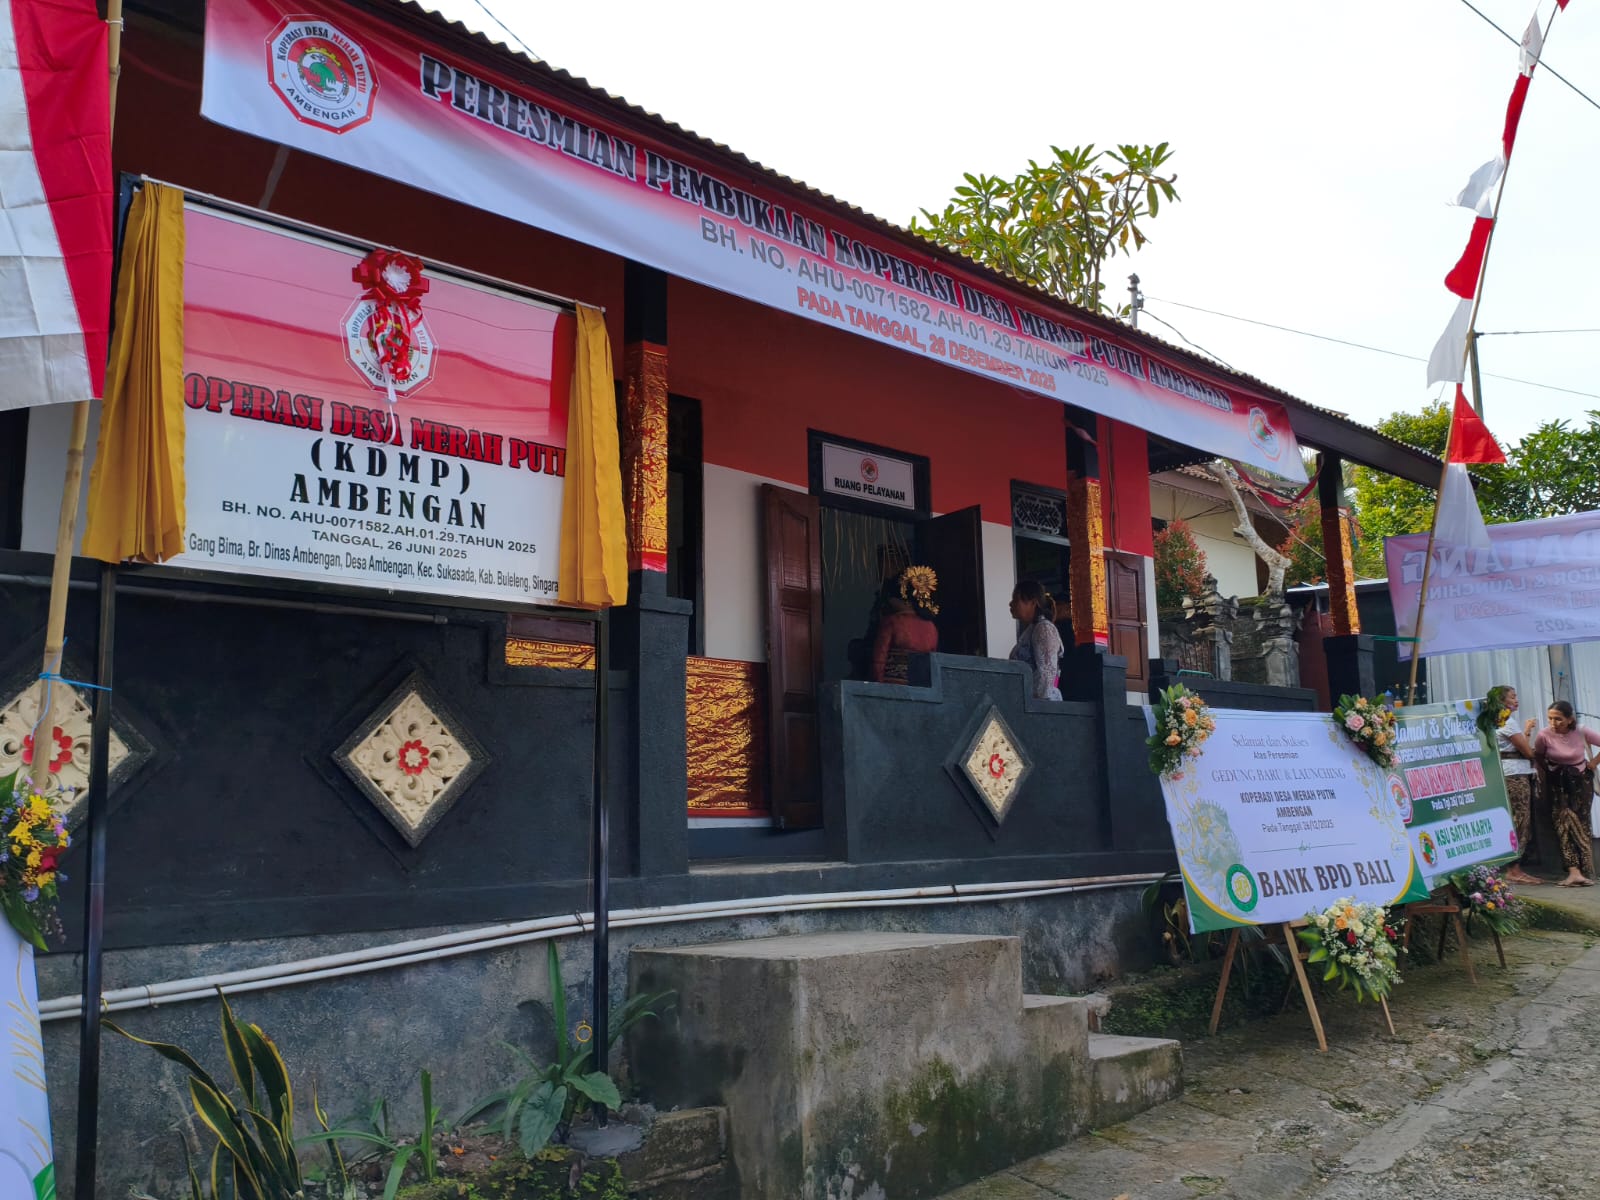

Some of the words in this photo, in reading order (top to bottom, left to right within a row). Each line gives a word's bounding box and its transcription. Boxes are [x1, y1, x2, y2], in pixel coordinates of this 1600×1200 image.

[277, 27, 304, 61] KOPERASI
[305, 26, 329, 39] DESA
[331, 32, 360, 63] MERAH
[355, 62, 367, 94] PUTIH
[286, 87, 356, 121] AMBENGAN
[420, 53, 636, 181] PERESMIAN
[644, 150, 828, 258] PEMBUKAAN
[831, 230, 960, 309] KOPERASI
[959, 282, 1017, 332] DESA
[1015, 306, 1088, 359] MERAH
[1088, 335, 1147, 381] PUTIH
[701, 216, 744, 255] BH.
[750, 237, 792, 273] NO.
[1073, 361, 1109, 387] 2025
[797, 287, 845, 323] PADA
[845, 304, 927, 353] TANGGAL,
[929, 334, 946, 357] 26
[948, 340, 1027, 383] DESEMBER
[1026, 367, 1056, 393] 2025
[184, 373, 324, 432] OPERASI
[330, 401, 403, 447] DESA
[410, 416, 503, 466] MERAH
[509, 436, 566, 478] PUTI
[289, 473, 487, 530] AMBENGAN
[834, 477, 861, 492] RUANG
[863, 483, 906, 501] PELAYANAN
[222, 500, 251, 515] BH.
[256, 504, 286, 520] NO.
[290, 510, 504, 549] AHU-0071582.AH.01.29.TAHUN
[507, 541, 537, 553] 2025
[311, 529, 383, 550] TANGGAL,
[387, 540, 402, 550] 26
[406, 542, 436, 556] JUNI
[439, 547, 468, 560] 2025
[189, 532, 215, 557] Gang
[218, 536, 246, 559] Bima,
[248, 540, 261, 557] Br.
[264, 542, 290, 562] Dinas
[293, 545, 343, 571] Ambengan,
[345, 552, 367, 570] Desa
[368, 555, 415, 578] Ambengan,
[417, 560, 435, 578] Kec.
[436, 563, 477, 584] Sukasada,
[478, 568, 496, 585] Kab.
[497, 570, 531, 592] Buleleng,
[532, 574, 559, 594] Singara
[1232, 734, 1265, 748] Selamat
[1266, 735, 1281, 748] dan
[1282, 735, 1309, 747] Sukses
[1391, 719, 1428, 744] lamat
[1443, 715, 1478, 740] Sukses
[1253, 751, 1267, 760] Atas
[1268, 750, 1299, 760] Peresmian
[1211, 769, 1256, 783] GEDUNG
[1292, 767, 1346, 780] LAUNCHING
[1240, 791, 1273, 804] KOPERASI
[1274, 790, 1291, 802] DESA
[1292, 789, 1316, 801] MERAH
[1316, 788, 1336, 800] PUTIH
[1276, 805, 1313, 818] AMBENGAN
[1278, 821, 1302, 834] Tanggal
[1434, 828, 1451, 847] KSU
[1450, 822, 1472, 843] SATYA
[1470, 817, 1494, 838] KARYA
[1257, 866, 1314, 898] BANK
[1314, 863, 1352, 892] BPD
[1353, 859, 1396, 886] BALI
